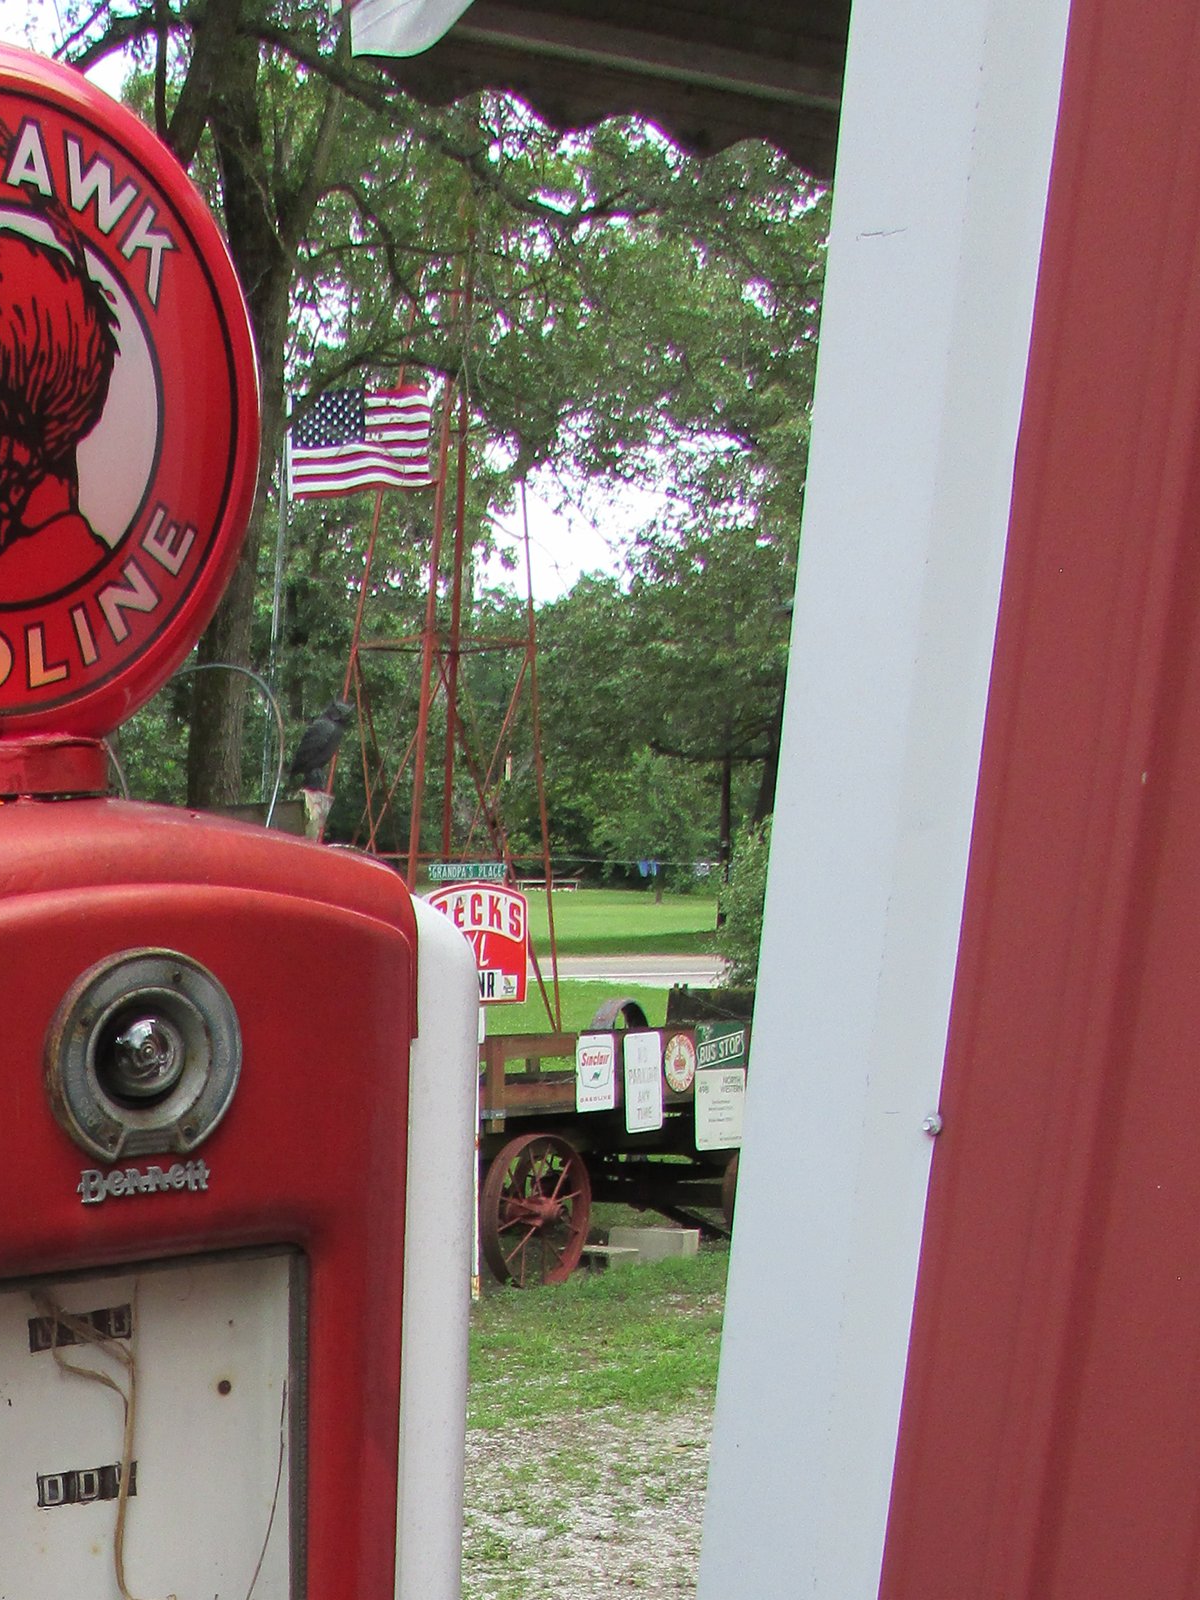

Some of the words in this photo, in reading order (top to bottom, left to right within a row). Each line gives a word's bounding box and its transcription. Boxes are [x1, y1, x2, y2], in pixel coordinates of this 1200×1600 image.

[432, 866, 473, 878] GRANDPA'S
[479, 865, 502, 877] PLACE
[700, 1044, 717, 1063] BUS
[720, 1034, 741, 1058] STOP
[581, 1051, 610, 1067] Sinclair
[580, 1094, 611, 1103] GASOLINE
[77, 1158, 211, 1204] Bennett
